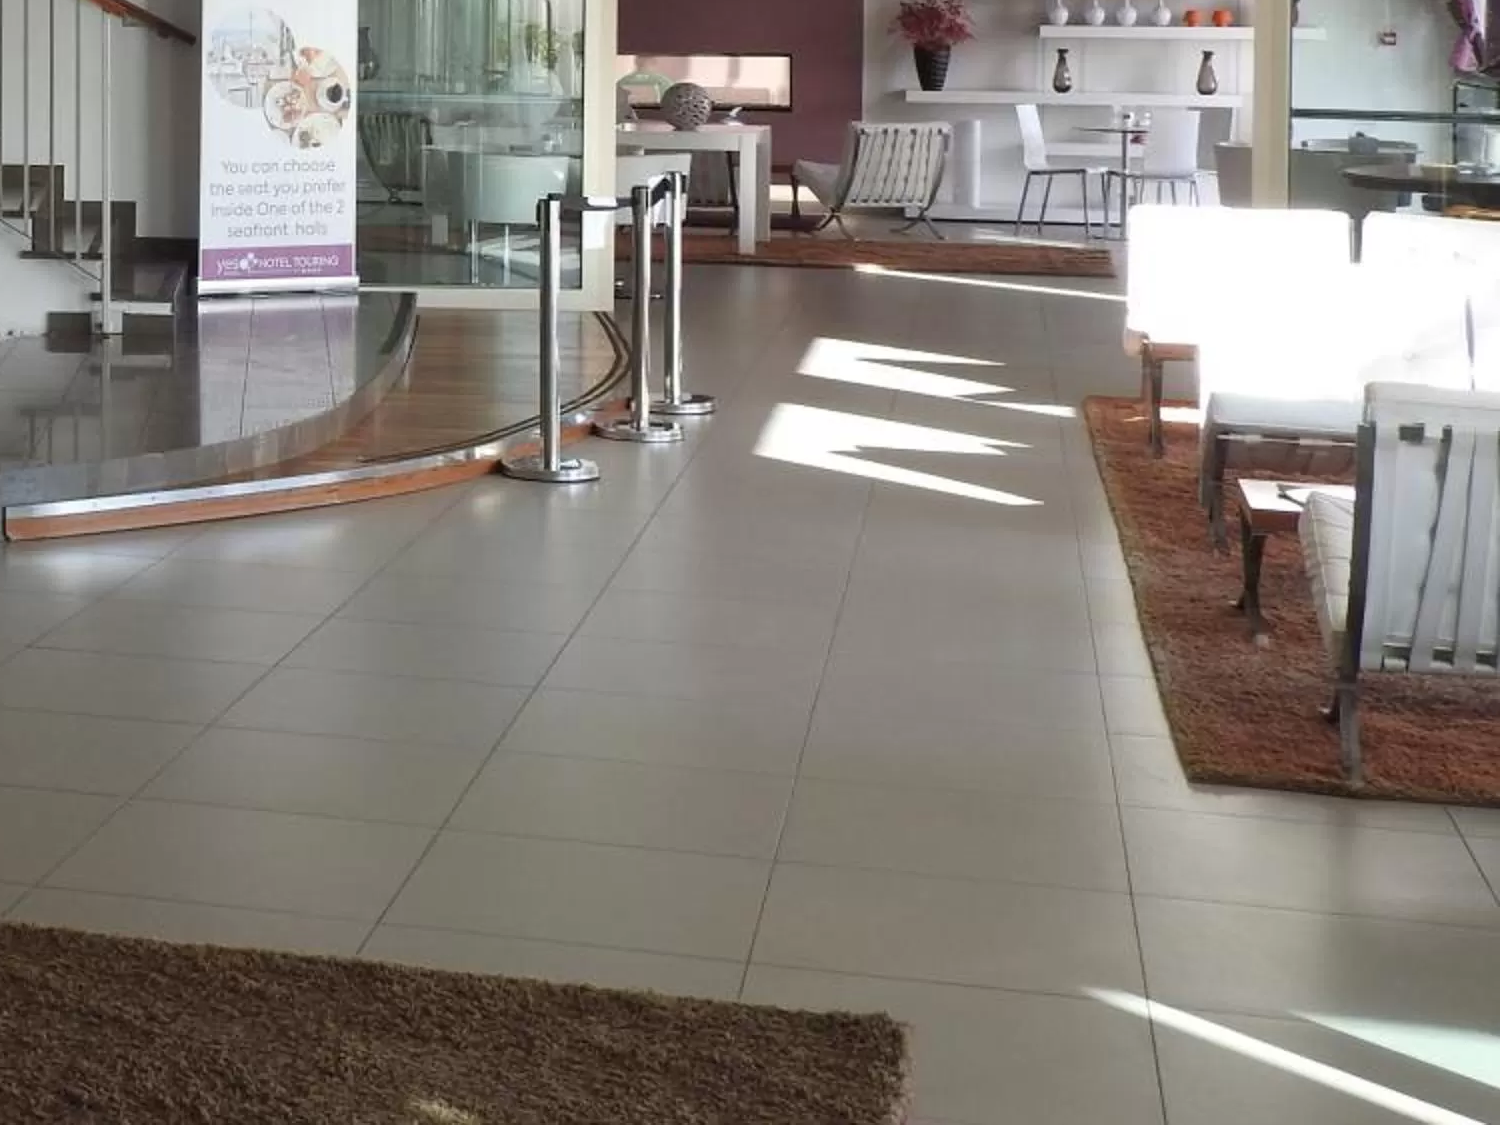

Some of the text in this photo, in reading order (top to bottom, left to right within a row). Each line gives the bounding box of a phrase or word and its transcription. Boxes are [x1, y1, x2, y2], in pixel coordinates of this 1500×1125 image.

[221, 159, 336, 174] You can choose
[209, 179, 346, 197] the seat you prefer
[257, 202, 288, 216] One
[292, 201, 306, 214] of
[309, 200, 332, 214] the
[336, 200, 345, 213] 2
[227, 223, 288, 238] seafront
[258, 257, 292, 268] HOTEL
[293, 255, 339, 267] TOURING
